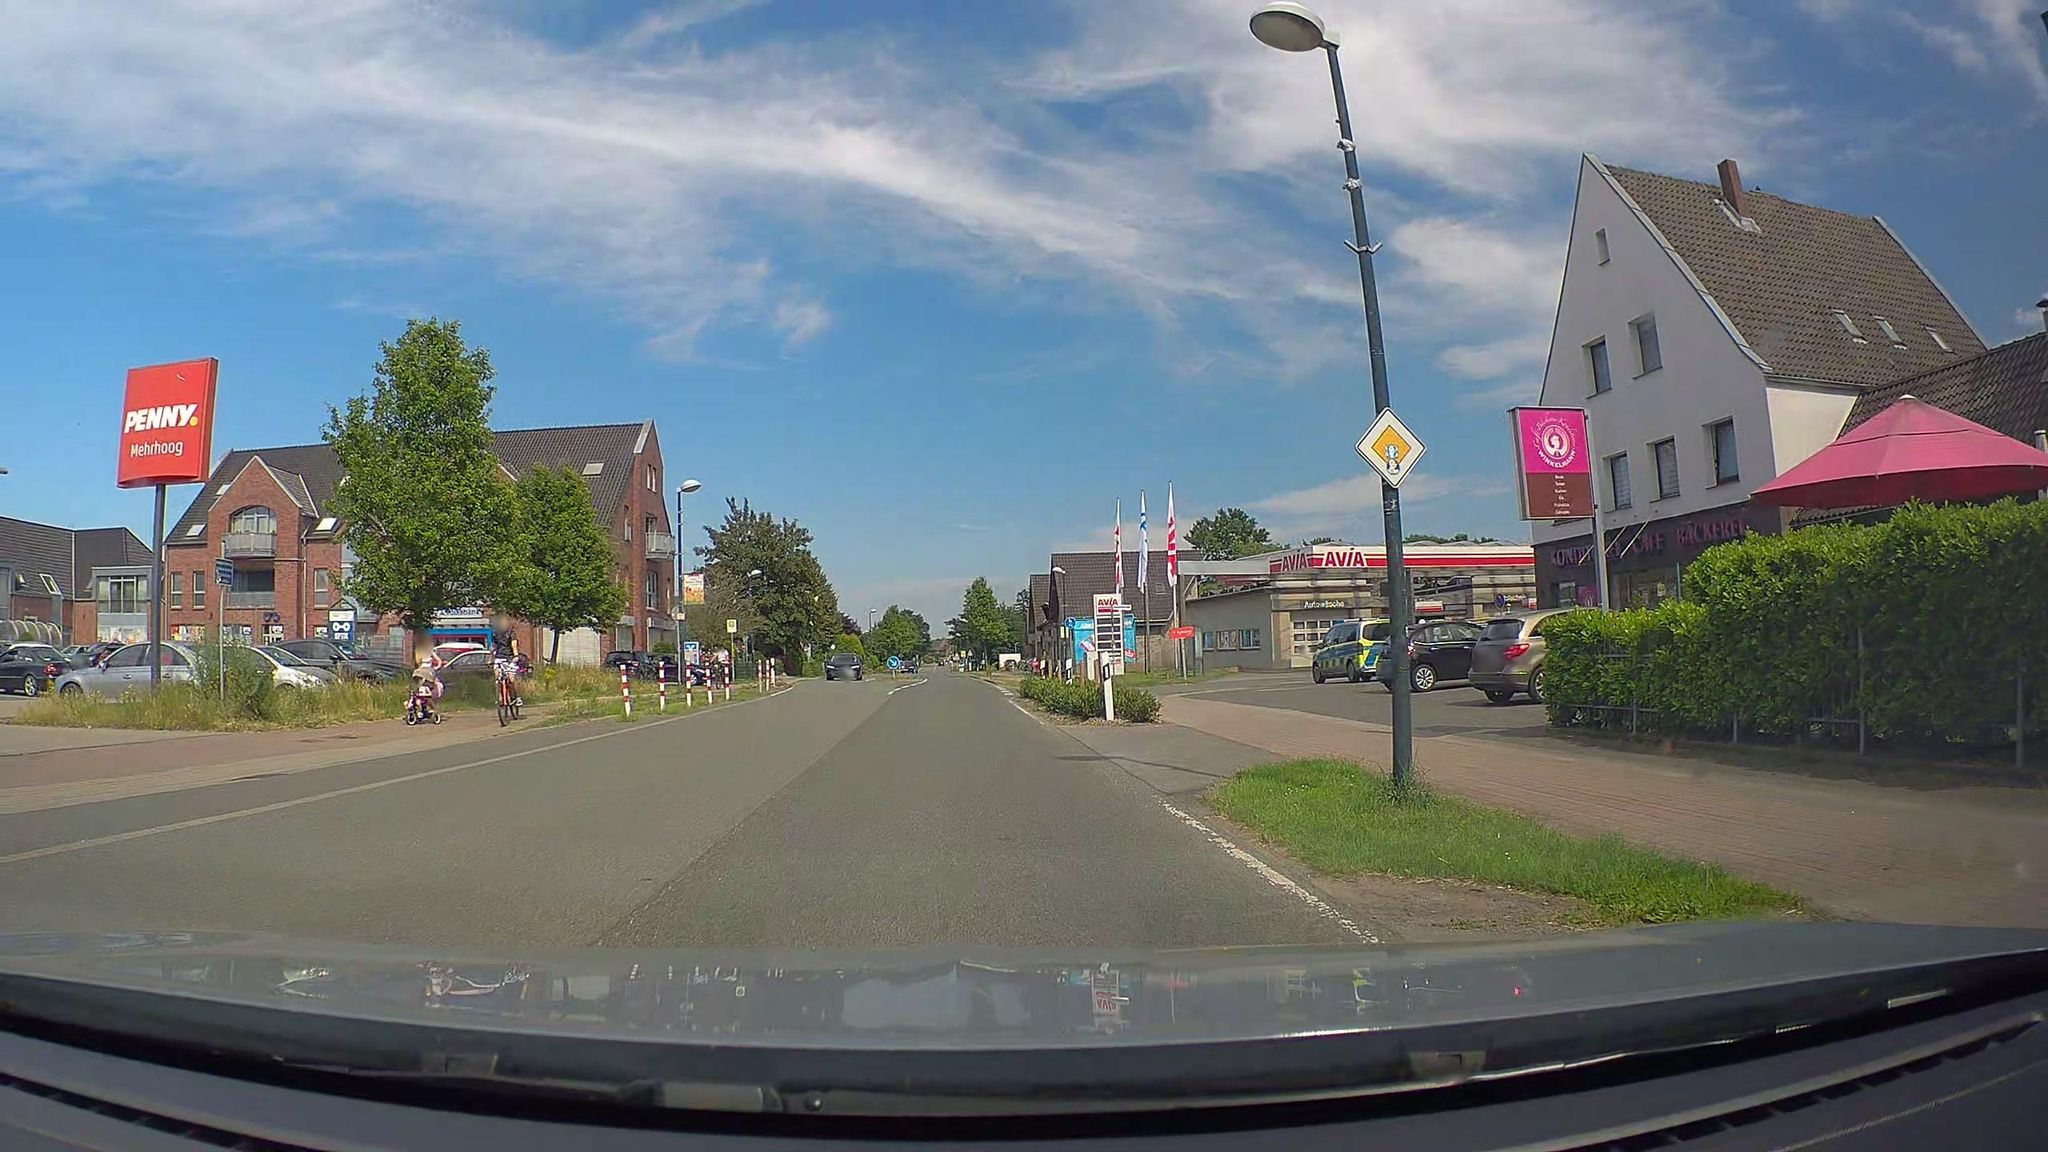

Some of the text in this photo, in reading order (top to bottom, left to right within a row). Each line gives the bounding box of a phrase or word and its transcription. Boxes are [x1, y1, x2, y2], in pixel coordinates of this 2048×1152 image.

[130, 440, 183, 457] Mehrhoog
[1538, 449, 1576, 468] WINKELMANN
[1282, 549, 1308, 572] AVIA
[1324, 548, 1364, 567] AVIA
[1098, 598, 1118, 606] AVIA
